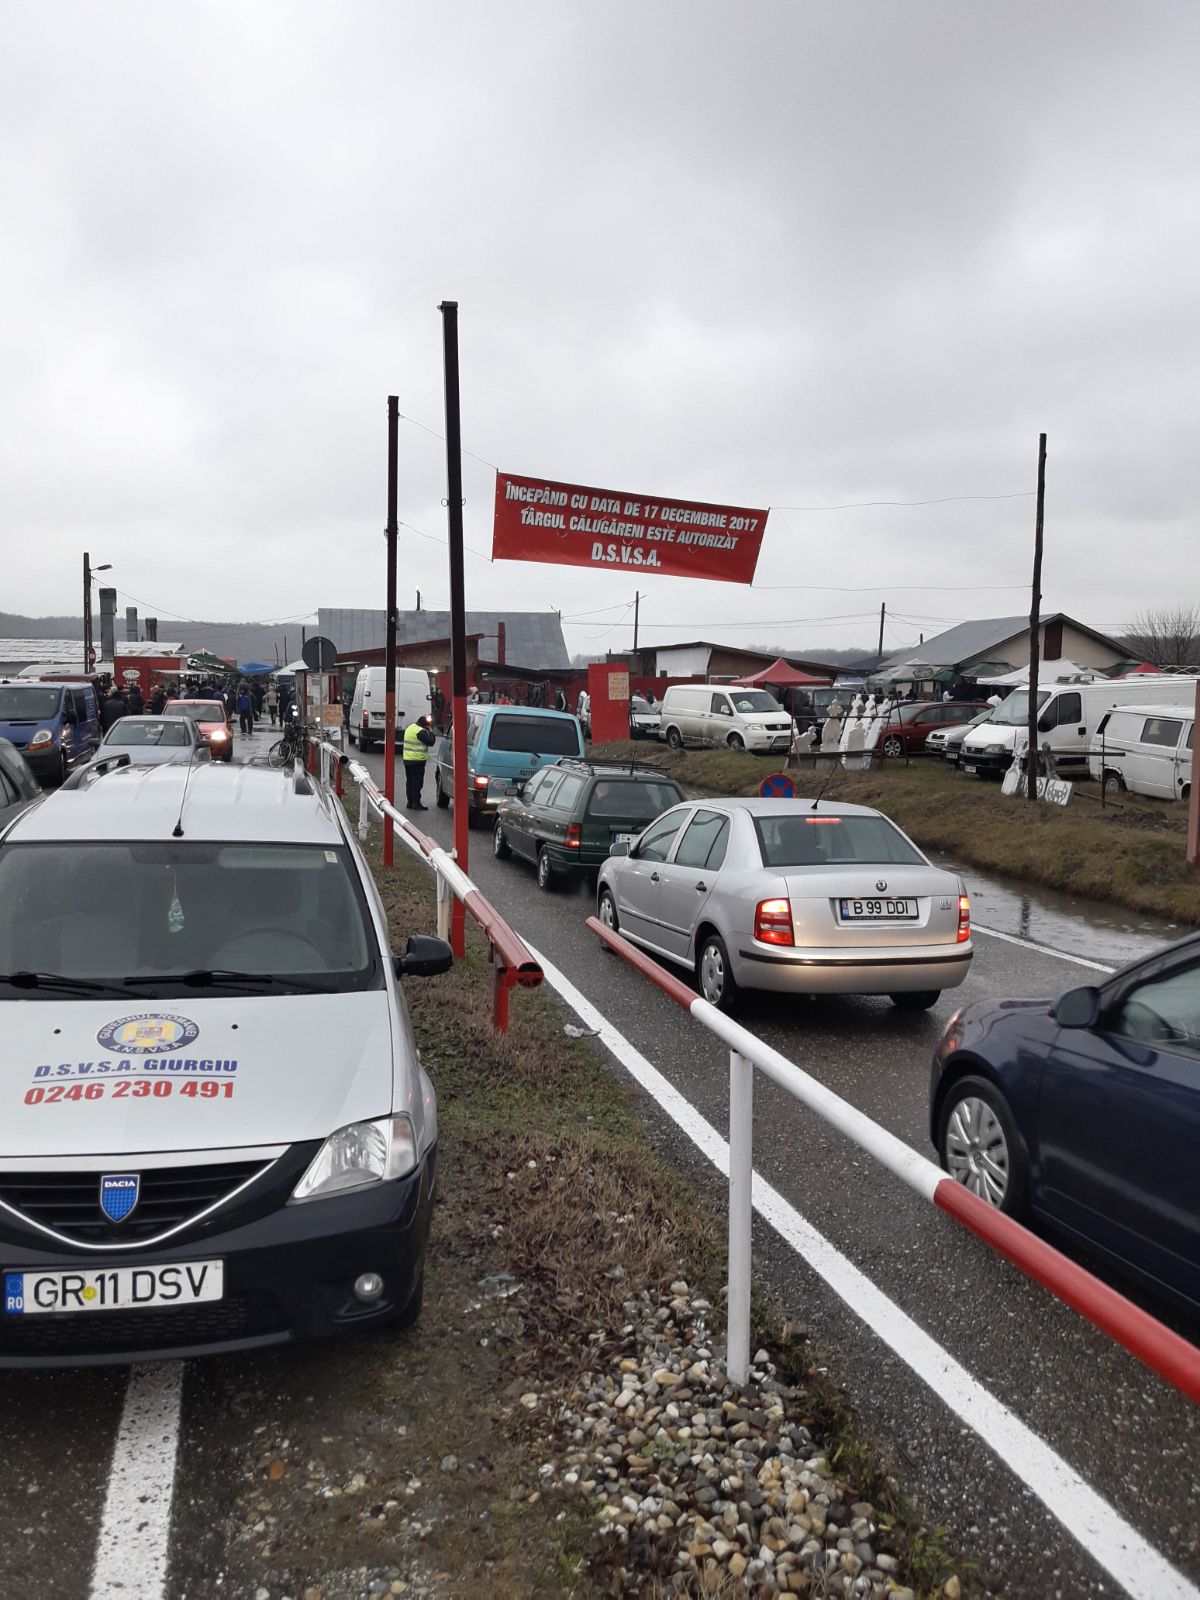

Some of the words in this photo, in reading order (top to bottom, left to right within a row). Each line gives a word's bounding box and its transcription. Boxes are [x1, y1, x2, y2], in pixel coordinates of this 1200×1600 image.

[505, 481, 567, 507] ÎNCEPÂND
[571, 494, 588, 510] CU
[590, 497, 620, 514] DATA
[624, 501, 641, 516] DE
[644, 504, 660, 519] 17
[661, 507, 728, 528] DECEMBRIE
[729, 516, 759, 532] 2017
[521, 507, 566, 530] TÂRGUL
[569, 514, 644, 539] CĂLUGĂRENI
[646, 526, 677, 542] ESTE
[676, 530, 739, 550] AUTORIZAT
[591, 542, 661, 567] D.S.V.S.A.
[853, 901, 864, 914] B
[866, 901, 882, 914] 99
[886, 901, 909, 914] DDI
[99, 1014, 154, 1040] GUVERNUL
[34, 1060, 137, 1079] D.S.V.S.A.
[143, 1059, 238, 1072] GIURGIU
[23, 1083, 105, 1106] 0246
[111, 1080, 173, 1099] 230
[180, 1081, 235, 1098] 491
[104, 1180, 136, 1188] DACIA
[33, 1275, 86, 1308] GR
[95, 1272, 119, 1305] 11
[131, 1264, 209, 1304] DSV
[7, 1296, 23, 1310] RO
